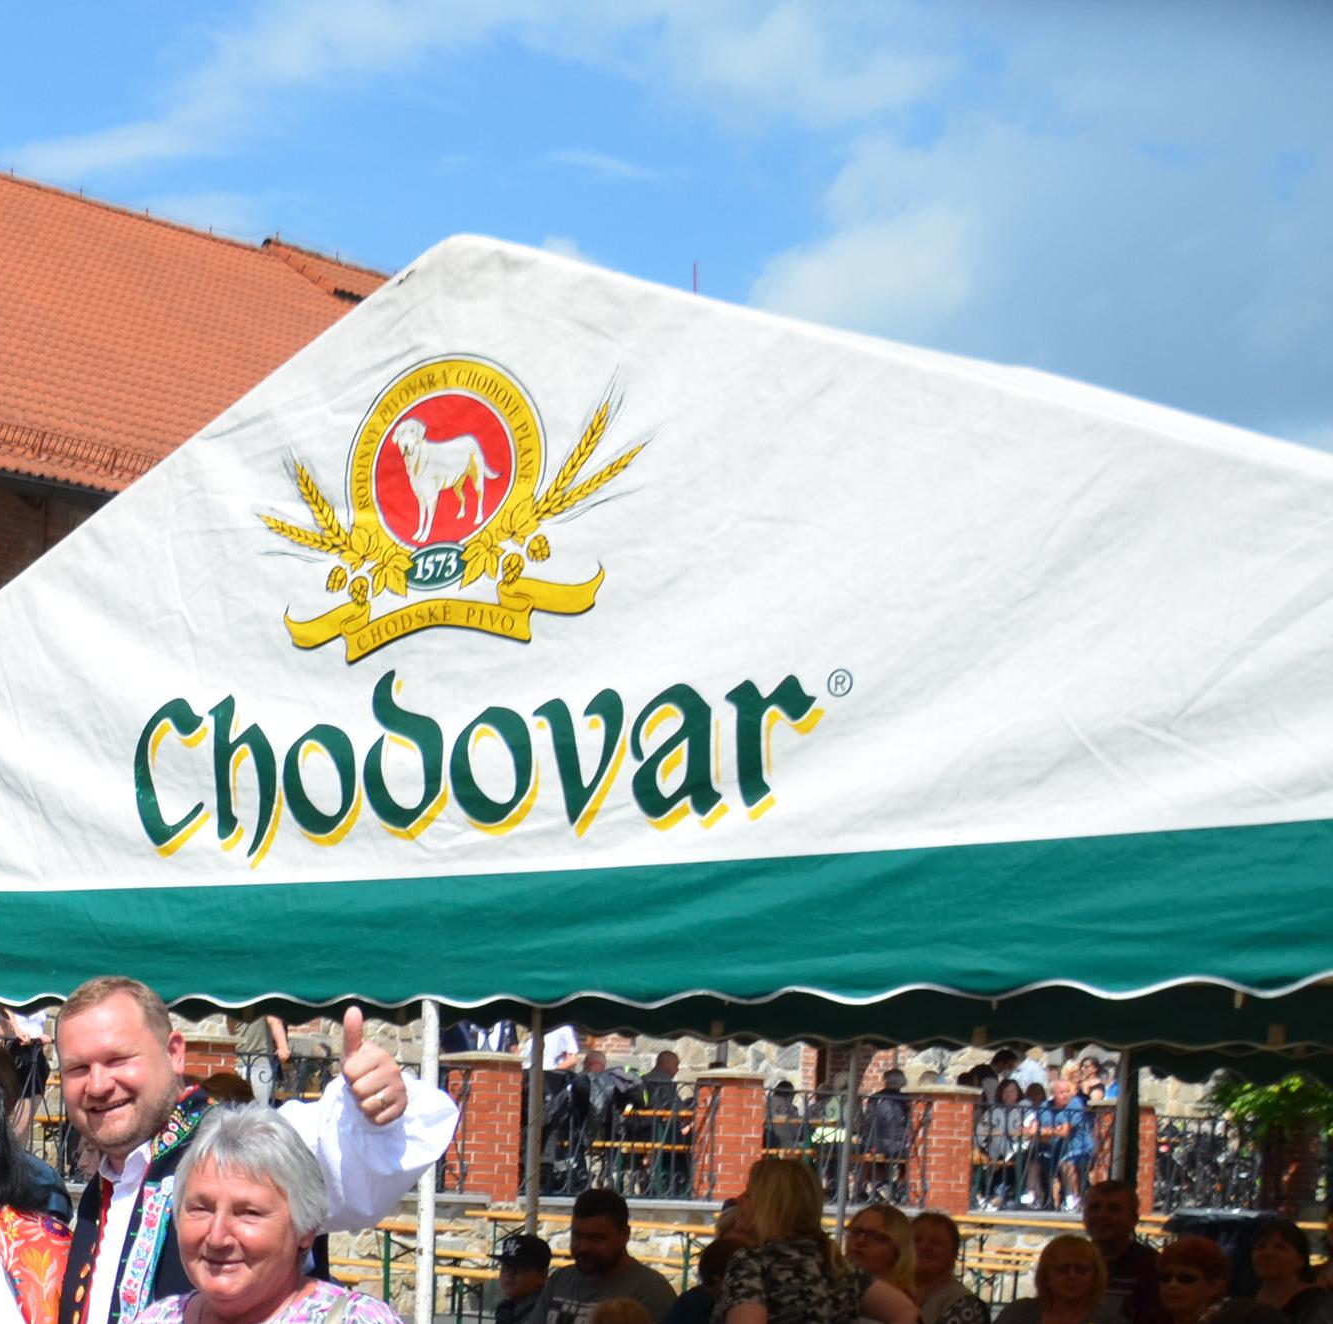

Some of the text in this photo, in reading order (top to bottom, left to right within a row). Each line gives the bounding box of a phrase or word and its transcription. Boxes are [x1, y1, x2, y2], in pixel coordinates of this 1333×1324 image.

[379, 373, 438, 424] PIVOVAR
[441, 370, 452, 386] V
[414, 552, 458, 581] 1573
[356, 601, 516, 651] CHODSKÉ PIVO
[133, 669, 825, 868] Chodovar
